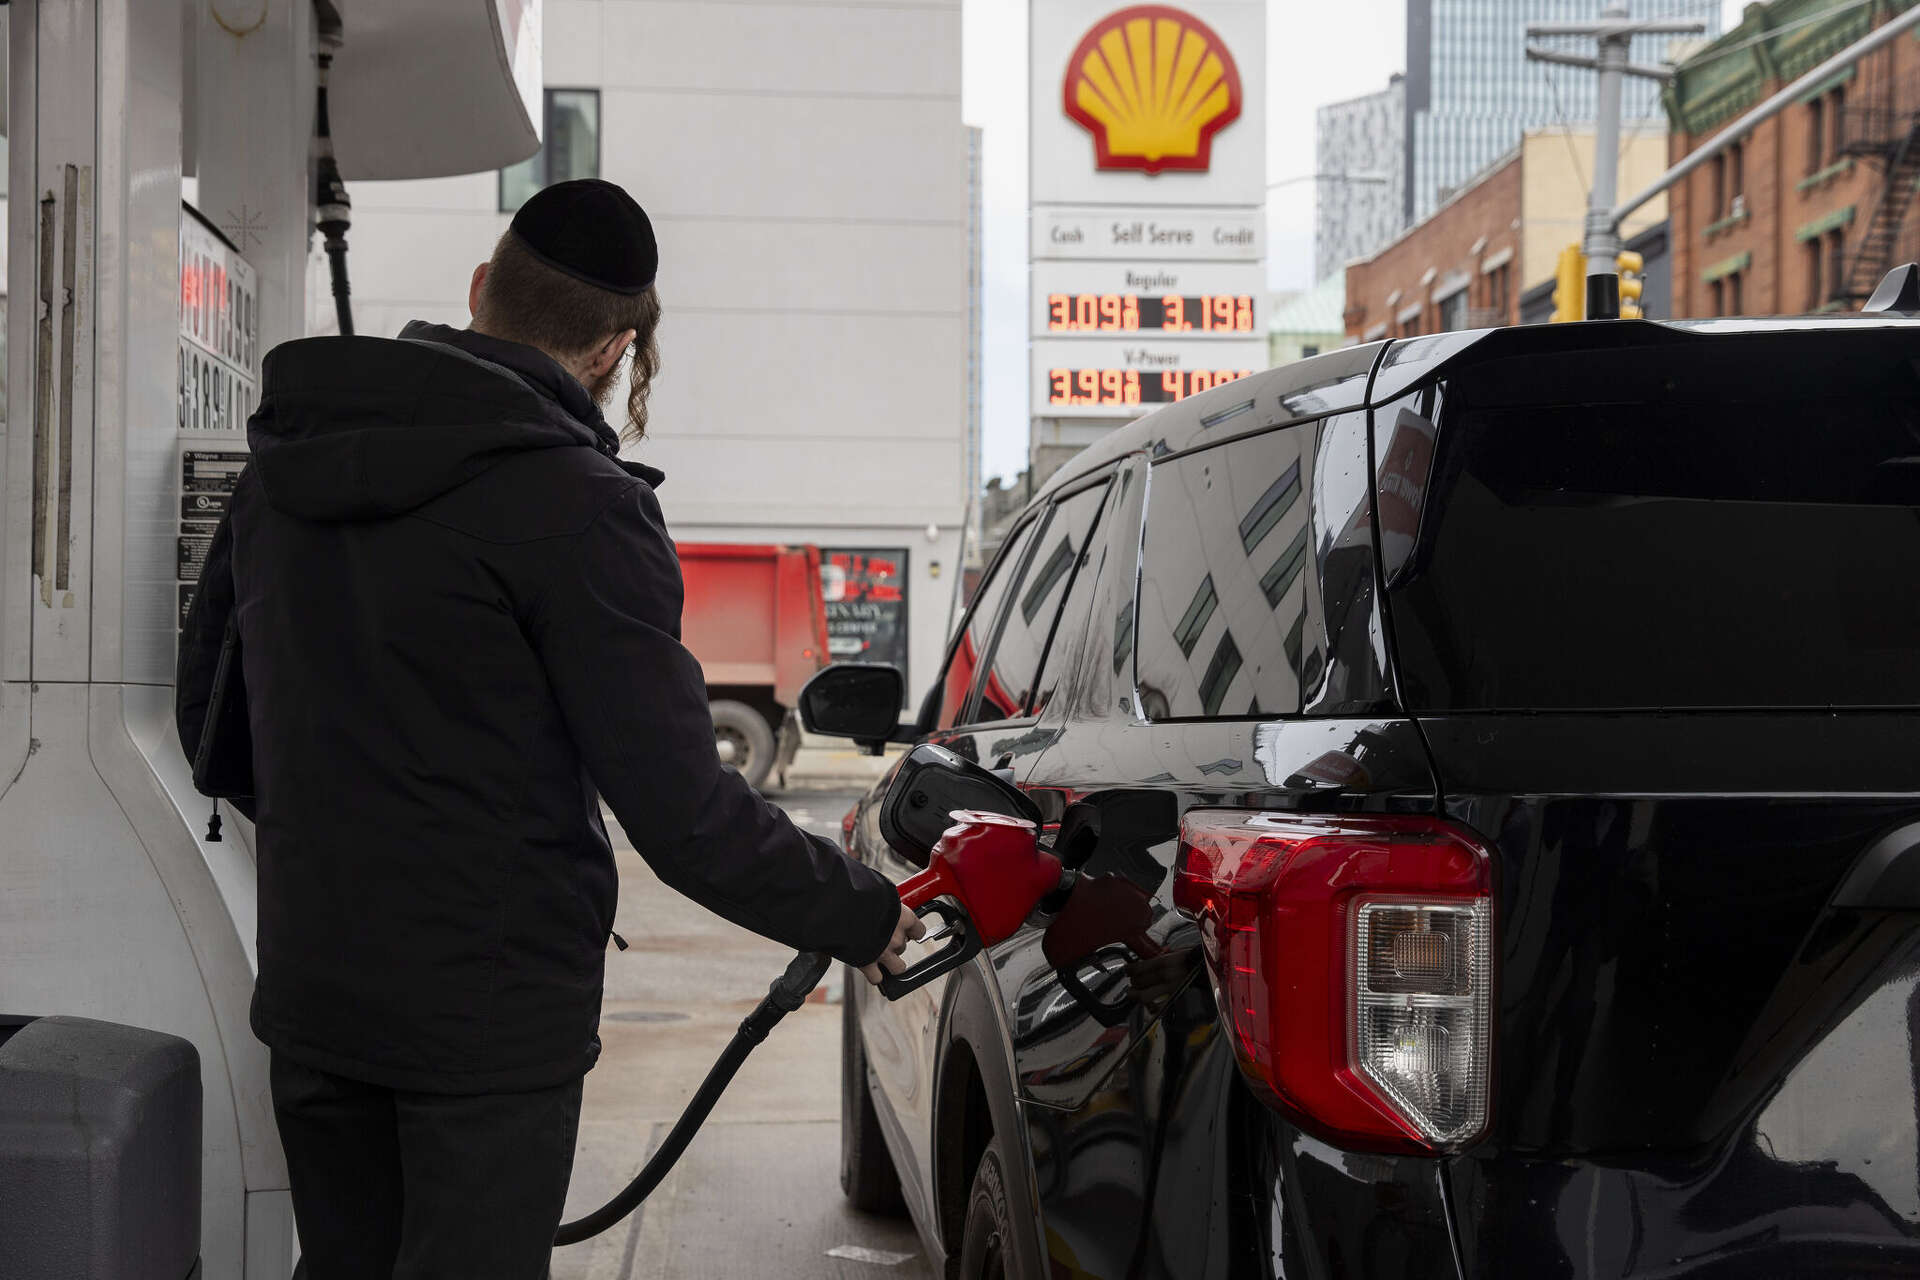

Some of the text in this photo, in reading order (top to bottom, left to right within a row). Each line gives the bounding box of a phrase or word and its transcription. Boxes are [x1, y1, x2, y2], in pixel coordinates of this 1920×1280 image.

[1051, 225, 1084, 244] Cash
[1112, 223, 1194, 244] Self Serve
[1213, 227, 1255, 245] Credit
[1125, 271, 1178, 290] Regular
[1123, 350, 1180, 366] V-Power
